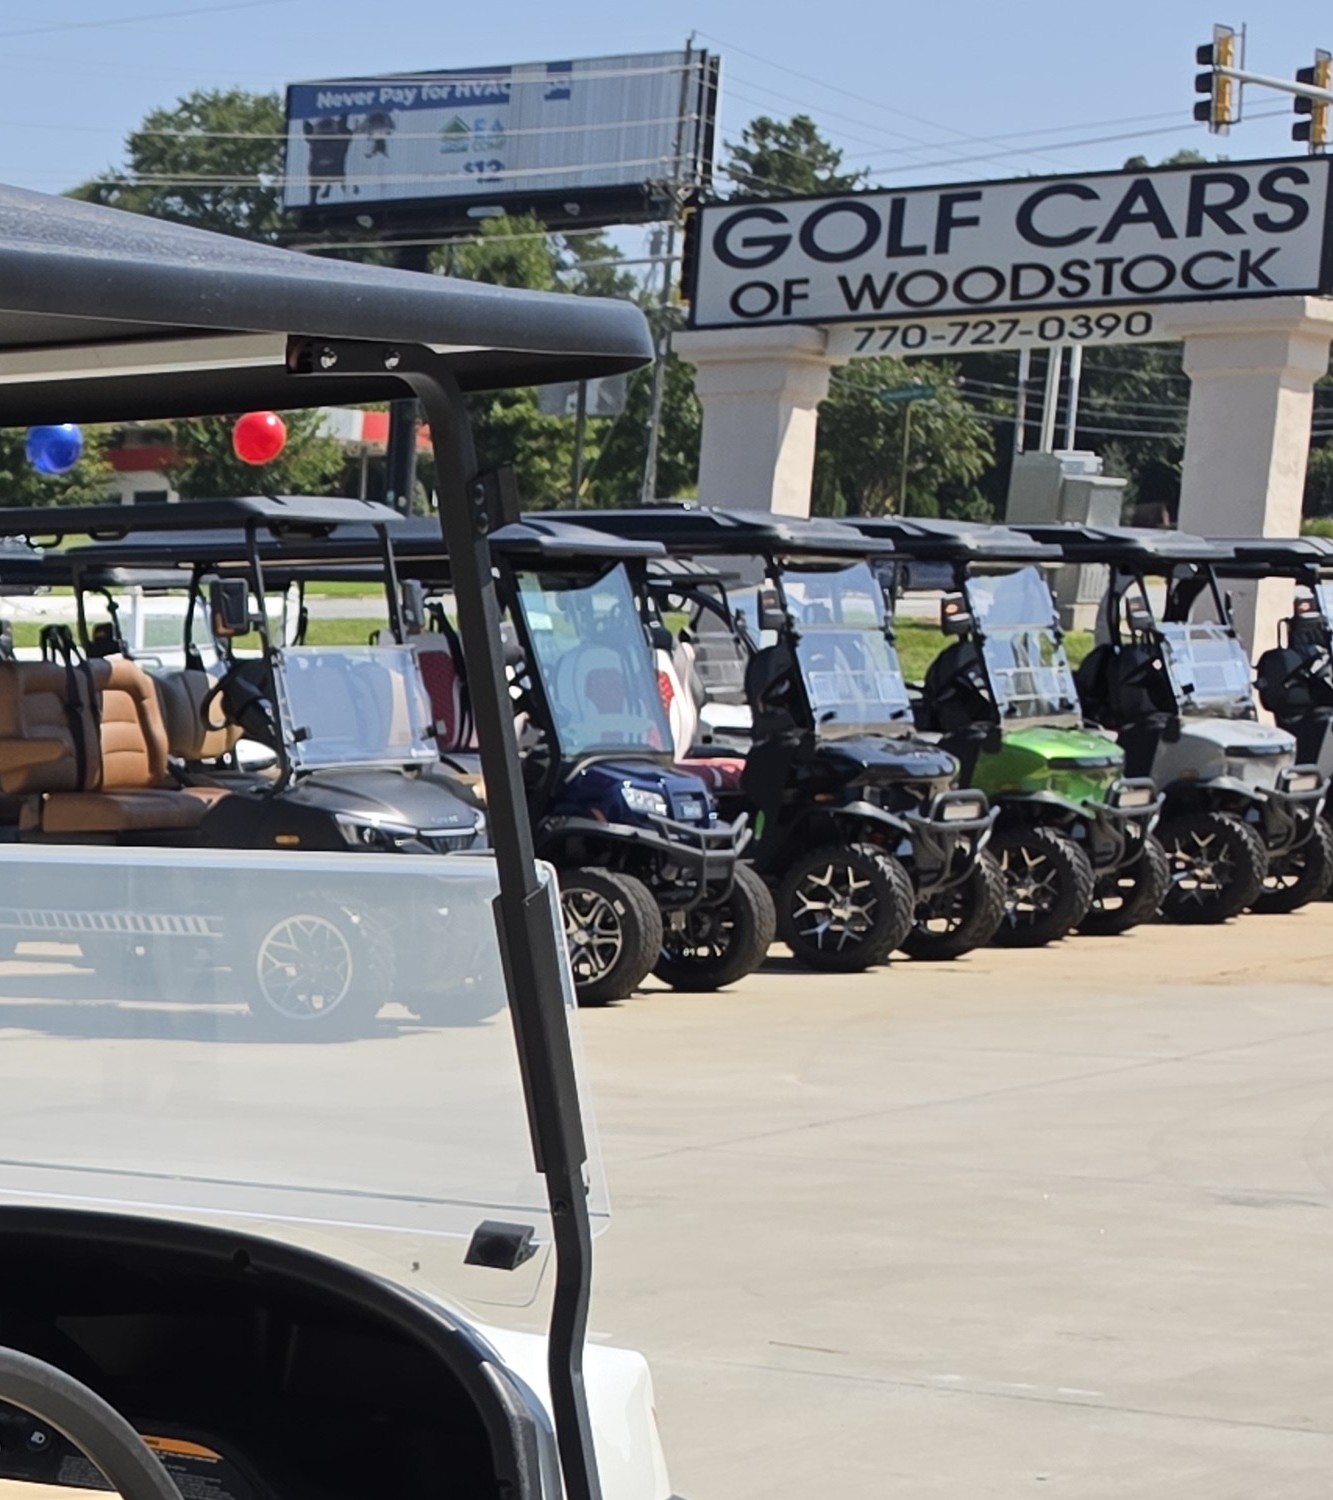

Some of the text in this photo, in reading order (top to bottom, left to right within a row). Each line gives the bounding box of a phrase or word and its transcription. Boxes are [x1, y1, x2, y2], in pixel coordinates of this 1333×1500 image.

[316, 90, 375, 109] Never
[379, 87, 417, 106] Pay
[712, 166, 1311, 269] GOLF CARS
[728, 247, 1282, 319] OF WOODSTOCK
[853, 311, 1154, 352] 770-727-0390
